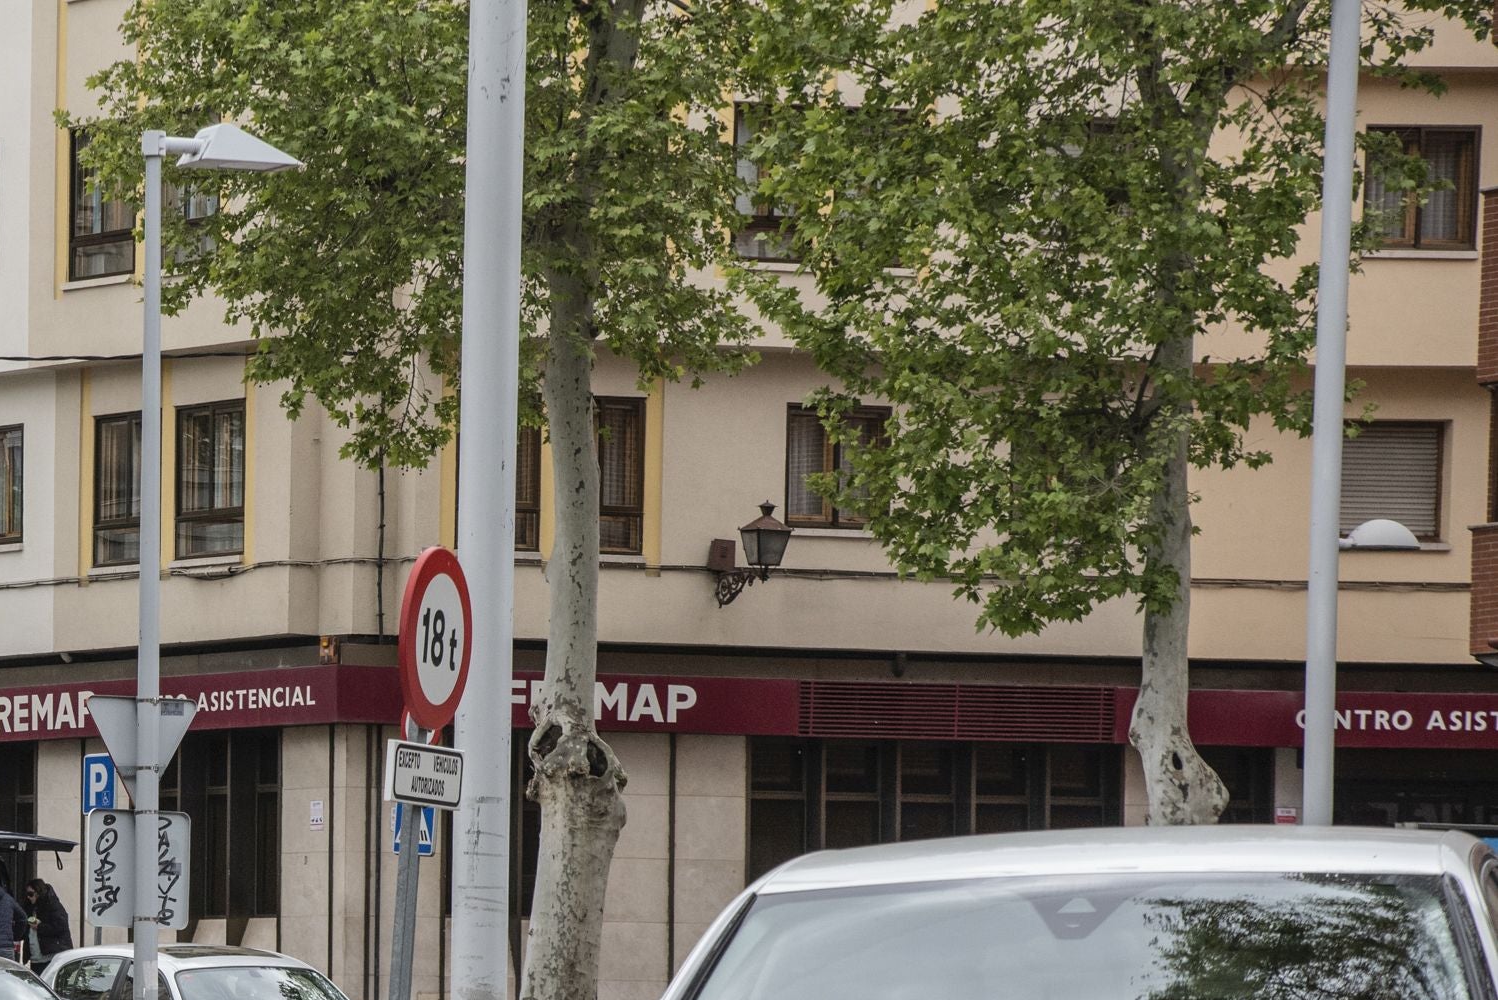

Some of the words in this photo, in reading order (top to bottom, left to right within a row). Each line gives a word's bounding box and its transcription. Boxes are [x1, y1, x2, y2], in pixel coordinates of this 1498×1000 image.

[422, 607, 445, 668] 18
[449, 627, 458, 672] t
[195, 685, 316, 713] ASISTENCIAL
[512, 679, 698, 724] FMAP
[1295, 709, 1414, 731] CNTRO
[398, 750, 421, 769] EXCEPTO
[89, 763, 108, 806] P
[410, 776, 445, 797] AUTORIZADOS
